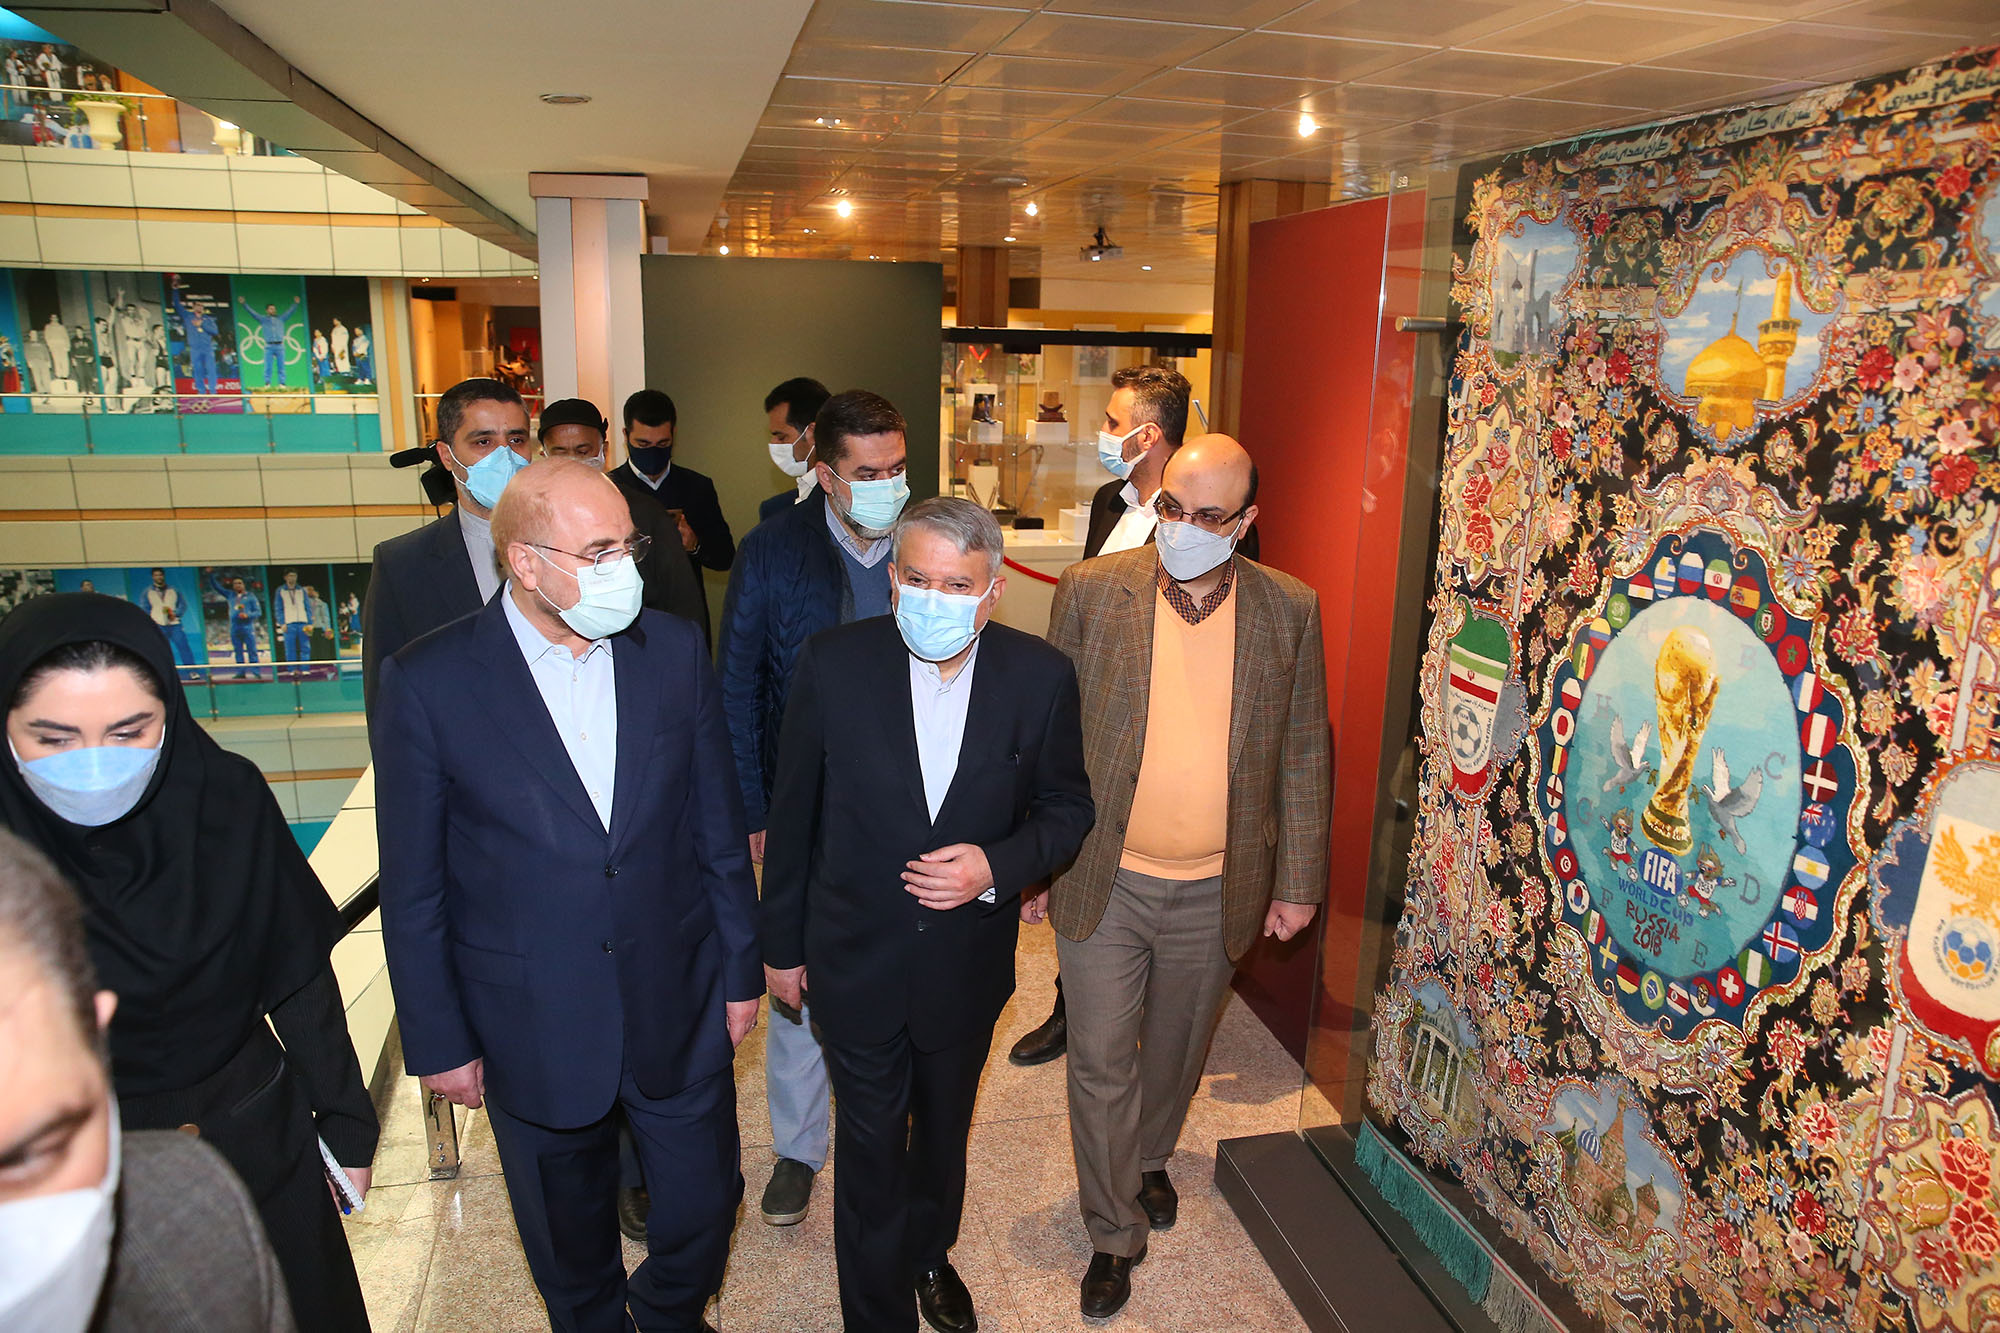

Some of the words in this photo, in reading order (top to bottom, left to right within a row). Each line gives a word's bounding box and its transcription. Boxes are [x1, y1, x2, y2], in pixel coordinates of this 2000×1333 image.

[1764, 751, 1787, 781] C
[1642, 850, 1677, 895] FIFA
[1740, 872, 1761, 905] D
[1618, 877, 1659, 908] WORLD
[1625, 899, 1681, 944] RUSSIA
[1632, 924, 1663, 957] 2018
[1691, 938, 1709, 969] E
